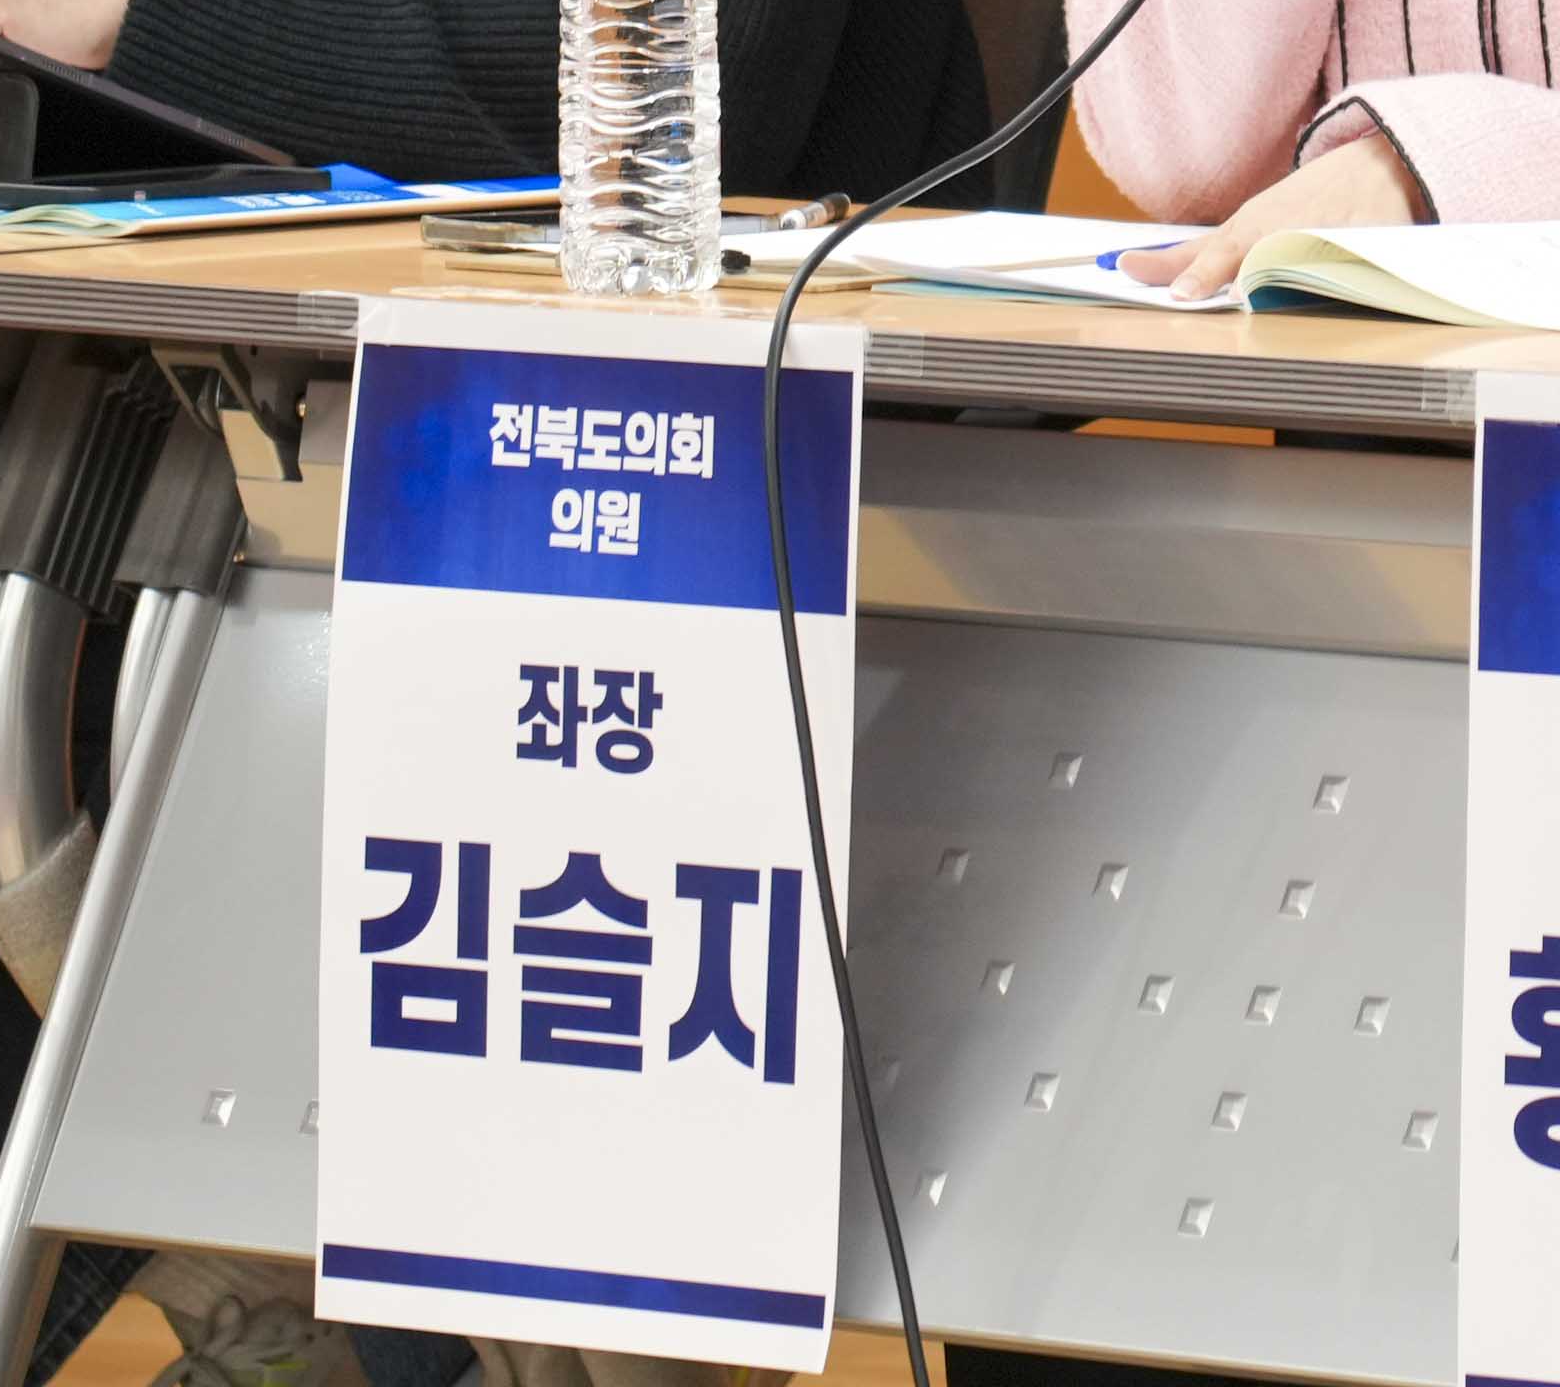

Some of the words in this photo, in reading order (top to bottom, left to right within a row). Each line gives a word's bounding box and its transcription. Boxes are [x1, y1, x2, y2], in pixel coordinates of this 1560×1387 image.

[489, 403, 715, 479] 전북도의회
[549, 488, 641, 556] 의원
[516, 663, 664, 775] 좌장
[359, 836, 803, 1085] 김슬지
